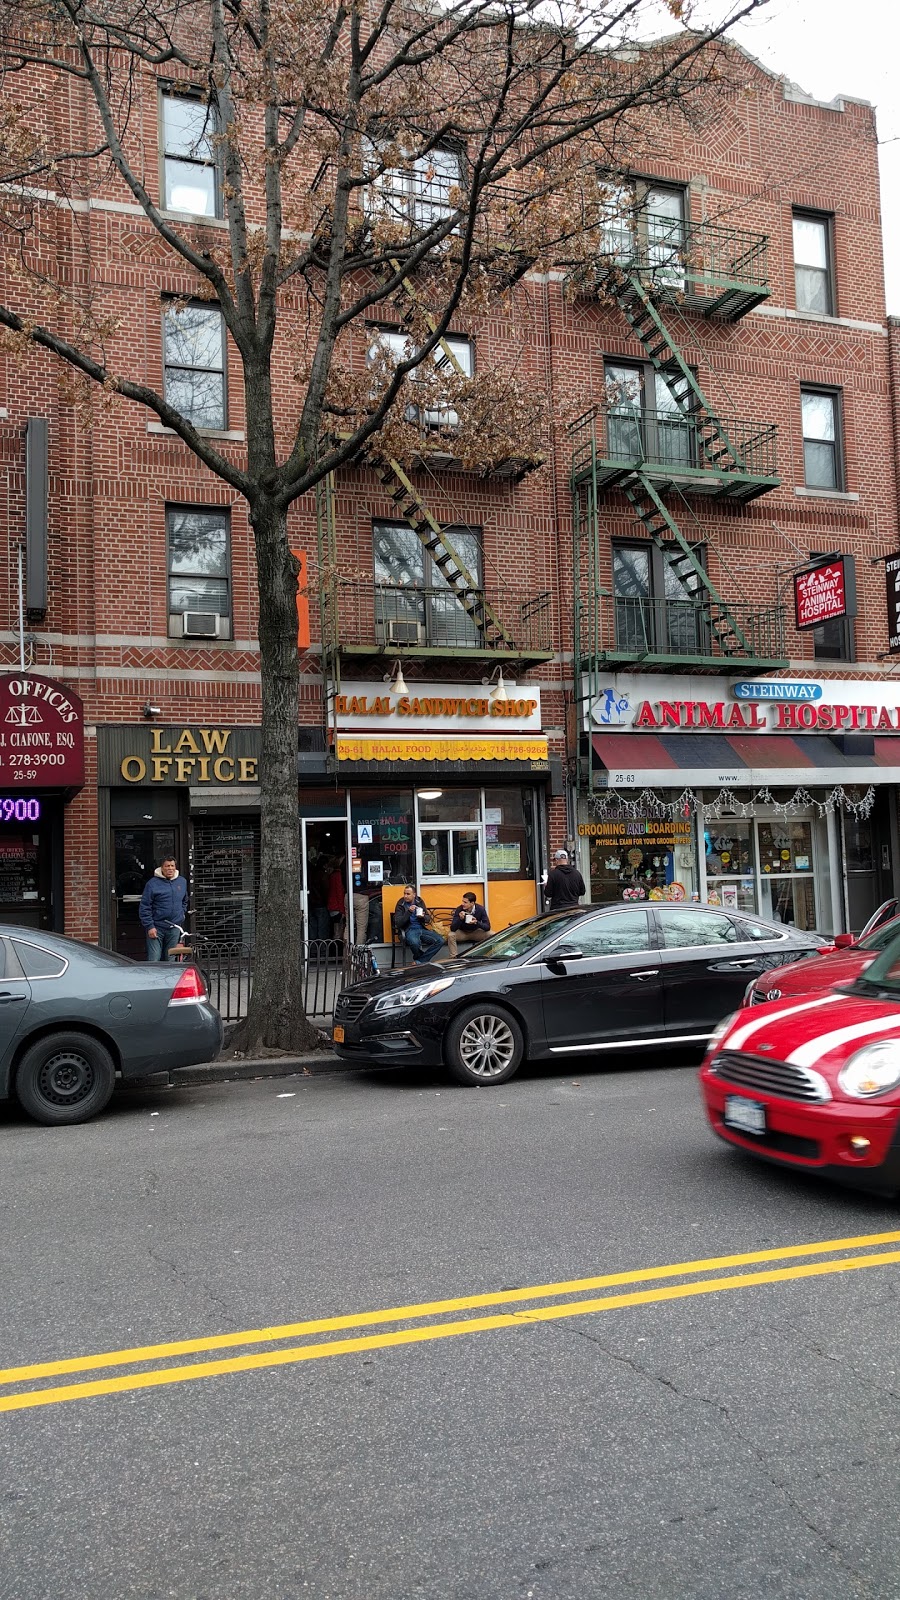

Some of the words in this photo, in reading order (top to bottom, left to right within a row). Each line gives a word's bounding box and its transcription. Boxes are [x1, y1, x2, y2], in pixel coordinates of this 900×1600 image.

[802, 578, 839, 598] STEINWAY
[805, 589, 838, 608] ANIMAL
[801, 598, 843, 619] HOSPITAL
[741, 684, 817, 698] STEINWAY
[8, 680, 79, 723] OFFICES
[335, 696, 395, 715] HALAL
[400, 697, 489, 716] SANDWICH
[494, 699, 538, 717] SHOP
[636, 701, 767, 728] ANIMAL
[10, 733, 53, 748] CIAFONE,
[56, 733, 75, 748] ESQ.
[151, 729, 231, 754] LAW
[338, 745, 364, 754] 25-61
[372, 745, 402, 753] HALAL
[406, 745, 431, 753] FOOD
[490, 745, 547, 754] 718-726-9262
[9, 754, 65, 766] 278-3900
[13, 770, 37, 780] 25-59
[121, 755, 259, 782] OFFICE
[615, 774, 635, 783] 25-63
[0, 799, 40, 821] 900
[360, 827, 370, 839] A
[578, 824, 626, 836] GROOMING
[627, 823, 646, 835] AND
[647, 822, 691, 834] BOARDING
[384, 843, 408, 852] FOOD
[595, 838, 619, 846] PHYSICAL
[619, 838, 633, 846] EXAM
[643, 837, 656, 845] YOUR
